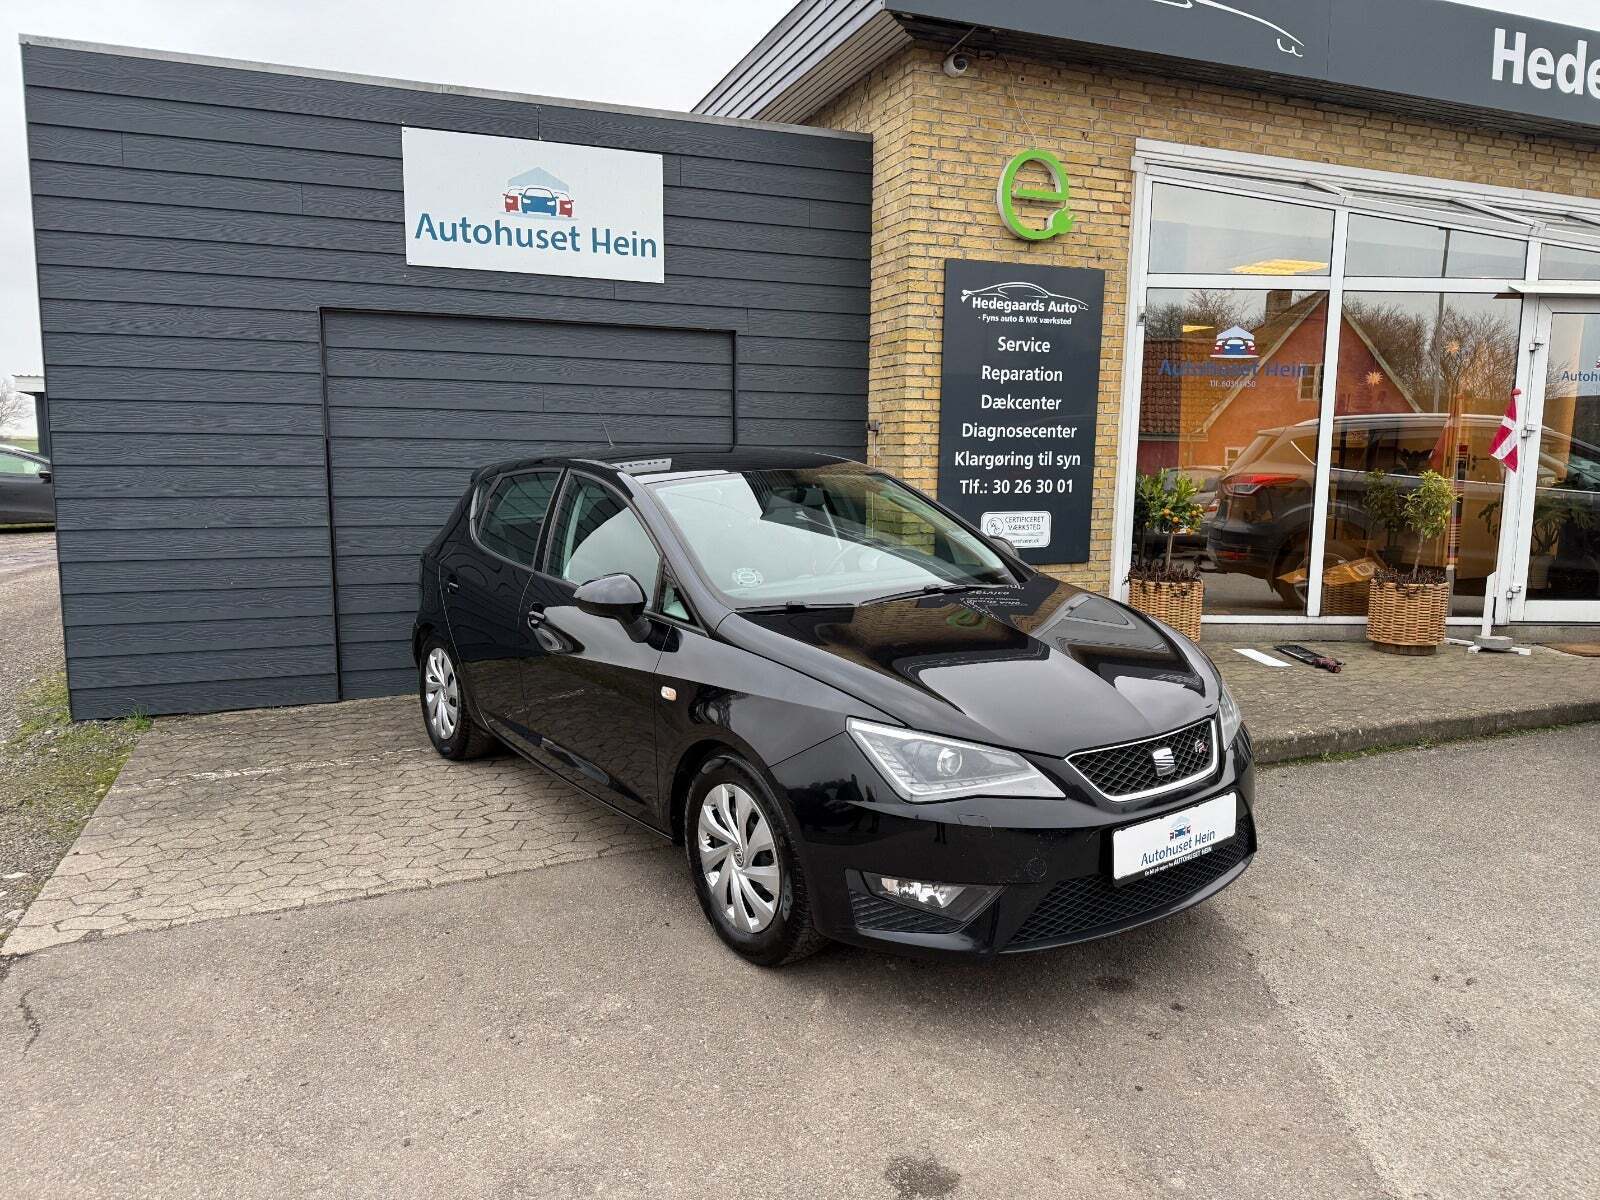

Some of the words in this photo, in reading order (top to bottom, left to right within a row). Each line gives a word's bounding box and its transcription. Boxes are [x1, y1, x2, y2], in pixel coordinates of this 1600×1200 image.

[415, 213, 581, 252] Autohuset
[592, 227, 657, 258] Hein
[972, 297, 1045, 313] Hedegaards
[1048, 300, 1078, 314] Auto
[982, 314, 999, 324] Fyns
[1026, 316, 1038, 324] MX
[1039, 317, 1072, 325] værksted
[998, 336, 1051, 353] Service
[982, 365, 1063, 384] Reparation
[1562, 370, 1600, 382] Autoh
[981, 394, 1062, 410] Dækcenter
[962, 422, 1078, 441] Diagnosecenter
[954, 451, 1034, 470] Klargøring
[1038, 451, 1053, 466] til
[1056, 455, 1081, 470] syn
[959, 479, 988, 494] Tlf.:
[992, 479, 1010, 494] 30
[1014, 479, 1032, 494] 26
[1036, 479, 1053, 494] 30
[1057, 479, 1073, 494] 01
[1004, 516, 1045, 524] CERTIFICERET
[1140, 838, 1192, 866] Autohuset
[1194, 830, 1216, 847] Hein
